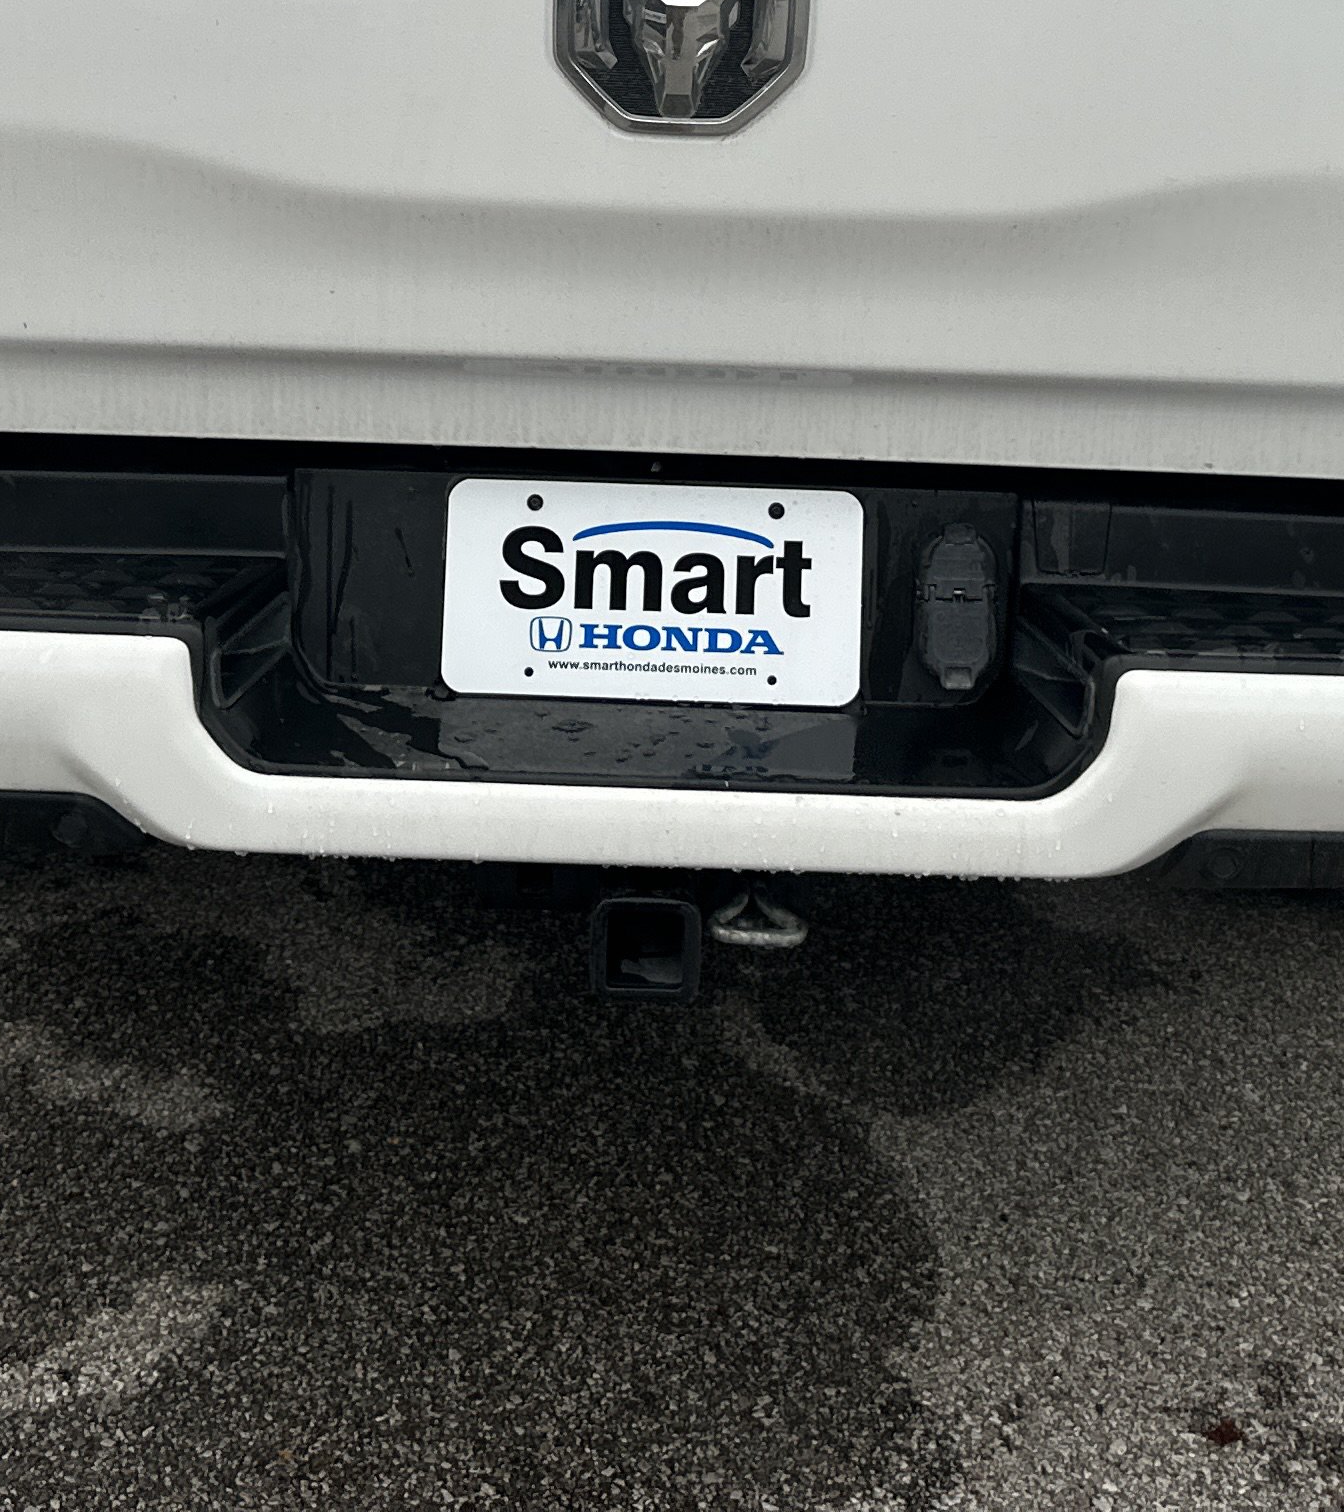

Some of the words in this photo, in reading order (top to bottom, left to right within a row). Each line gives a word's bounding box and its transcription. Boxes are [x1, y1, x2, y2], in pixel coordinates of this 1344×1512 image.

[499, 524, 812, 618] Smart
[579, 623, 784, 655] HONDA
[548, 659, 757, 676] www.smarthondadesmoines.com
